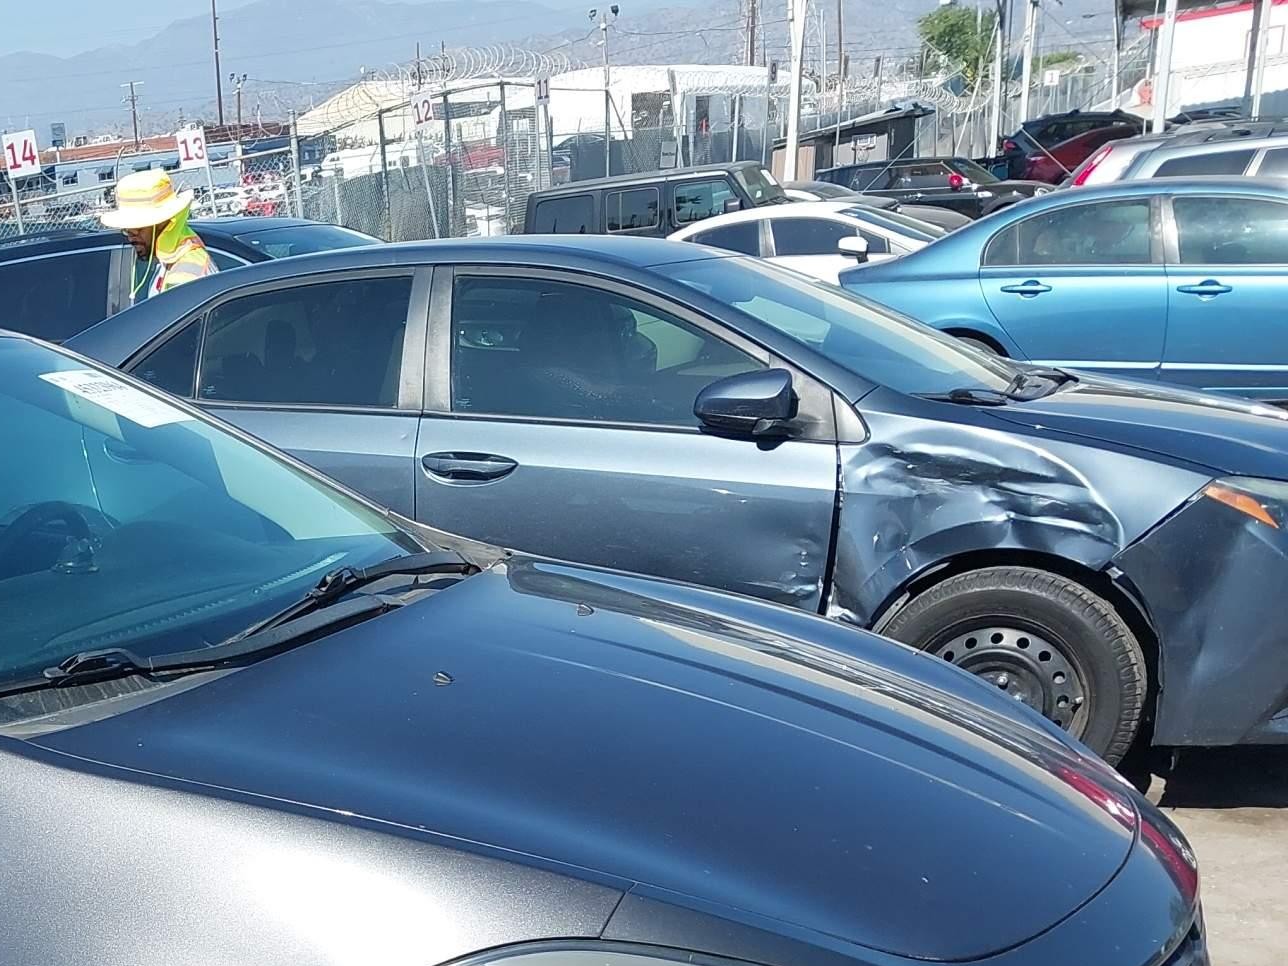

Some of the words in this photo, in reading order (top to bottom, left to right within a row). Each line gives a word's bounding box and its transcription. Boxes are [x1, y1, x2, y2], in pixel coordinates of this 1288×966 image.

[536, 79, 551, 100] 11
[414, 99, 433, 125] 12
[6, 139, 37, 170] 14
[179, 137, 205, 161] 13
